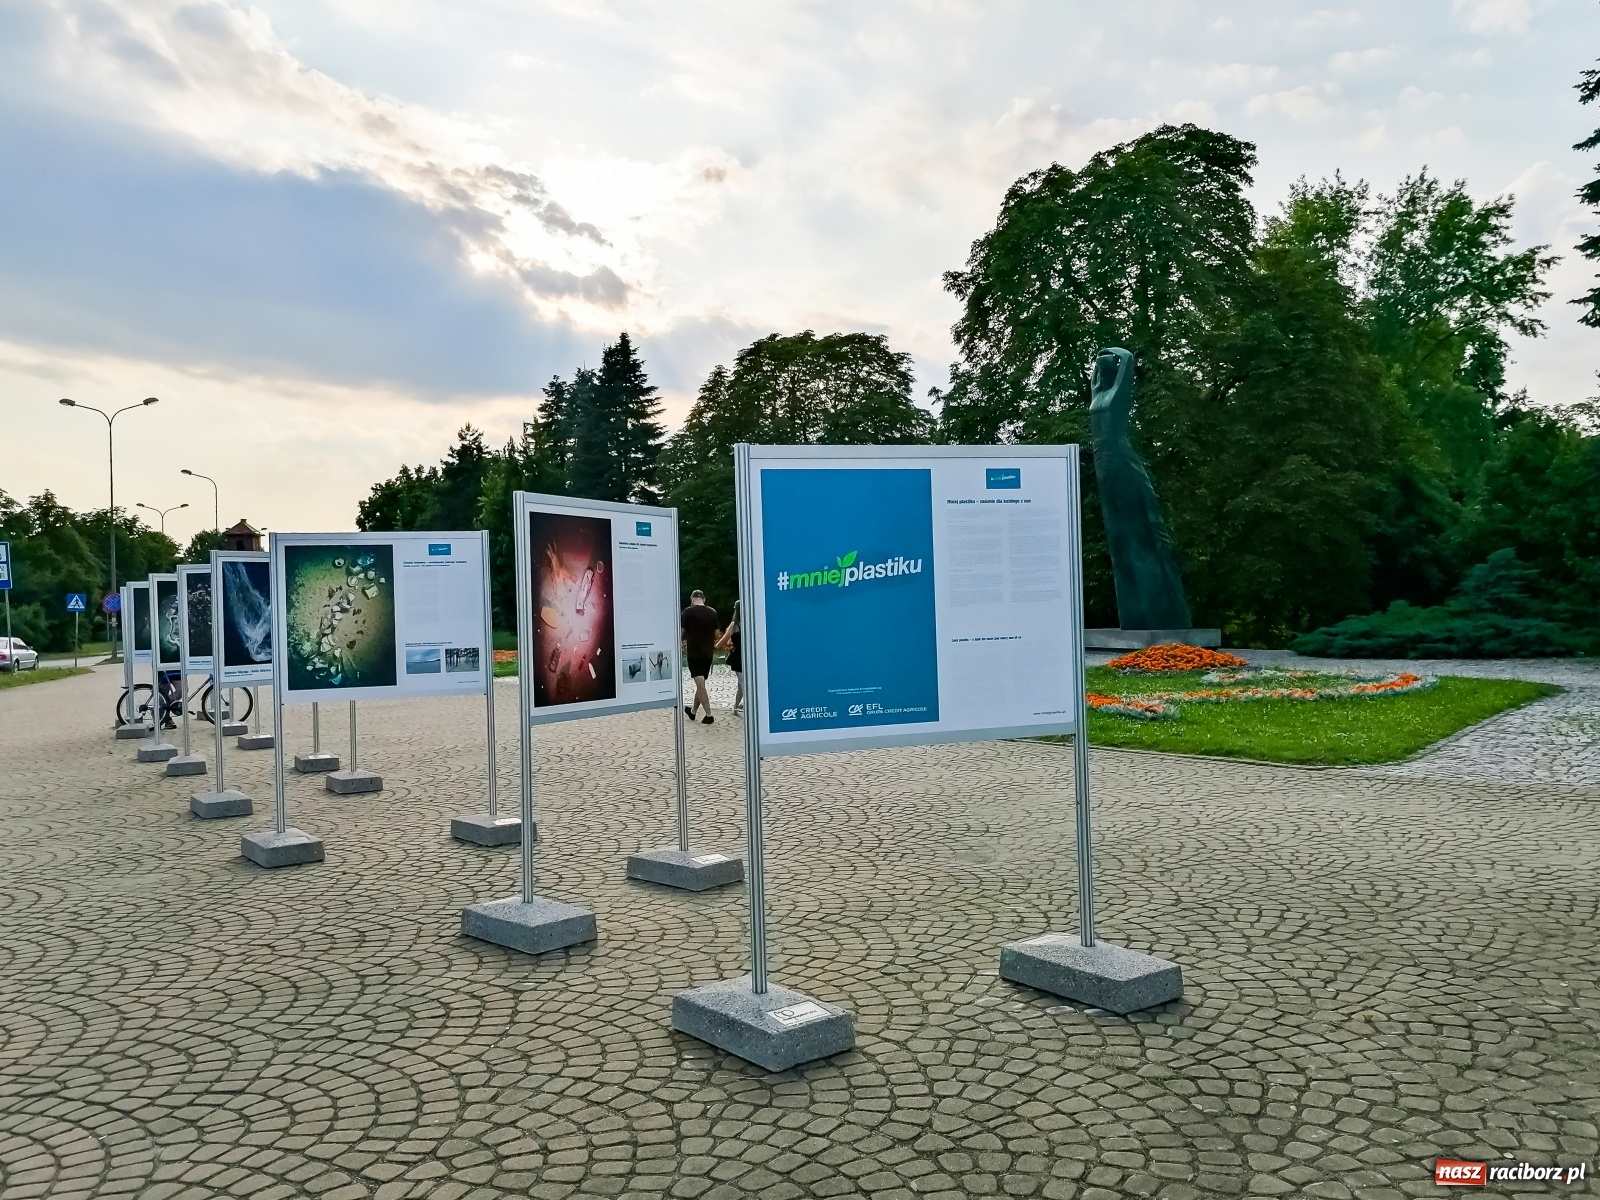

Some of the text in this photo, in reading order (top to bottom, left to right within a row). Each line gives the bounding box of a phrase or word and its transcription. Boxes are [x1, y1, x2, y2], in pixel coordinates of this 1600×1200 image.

[777, 556, 922, 591] #mniejplastiku
[866, 703, 884, 711] EFL
[800, 711, 838, 720] AGRICOLE
